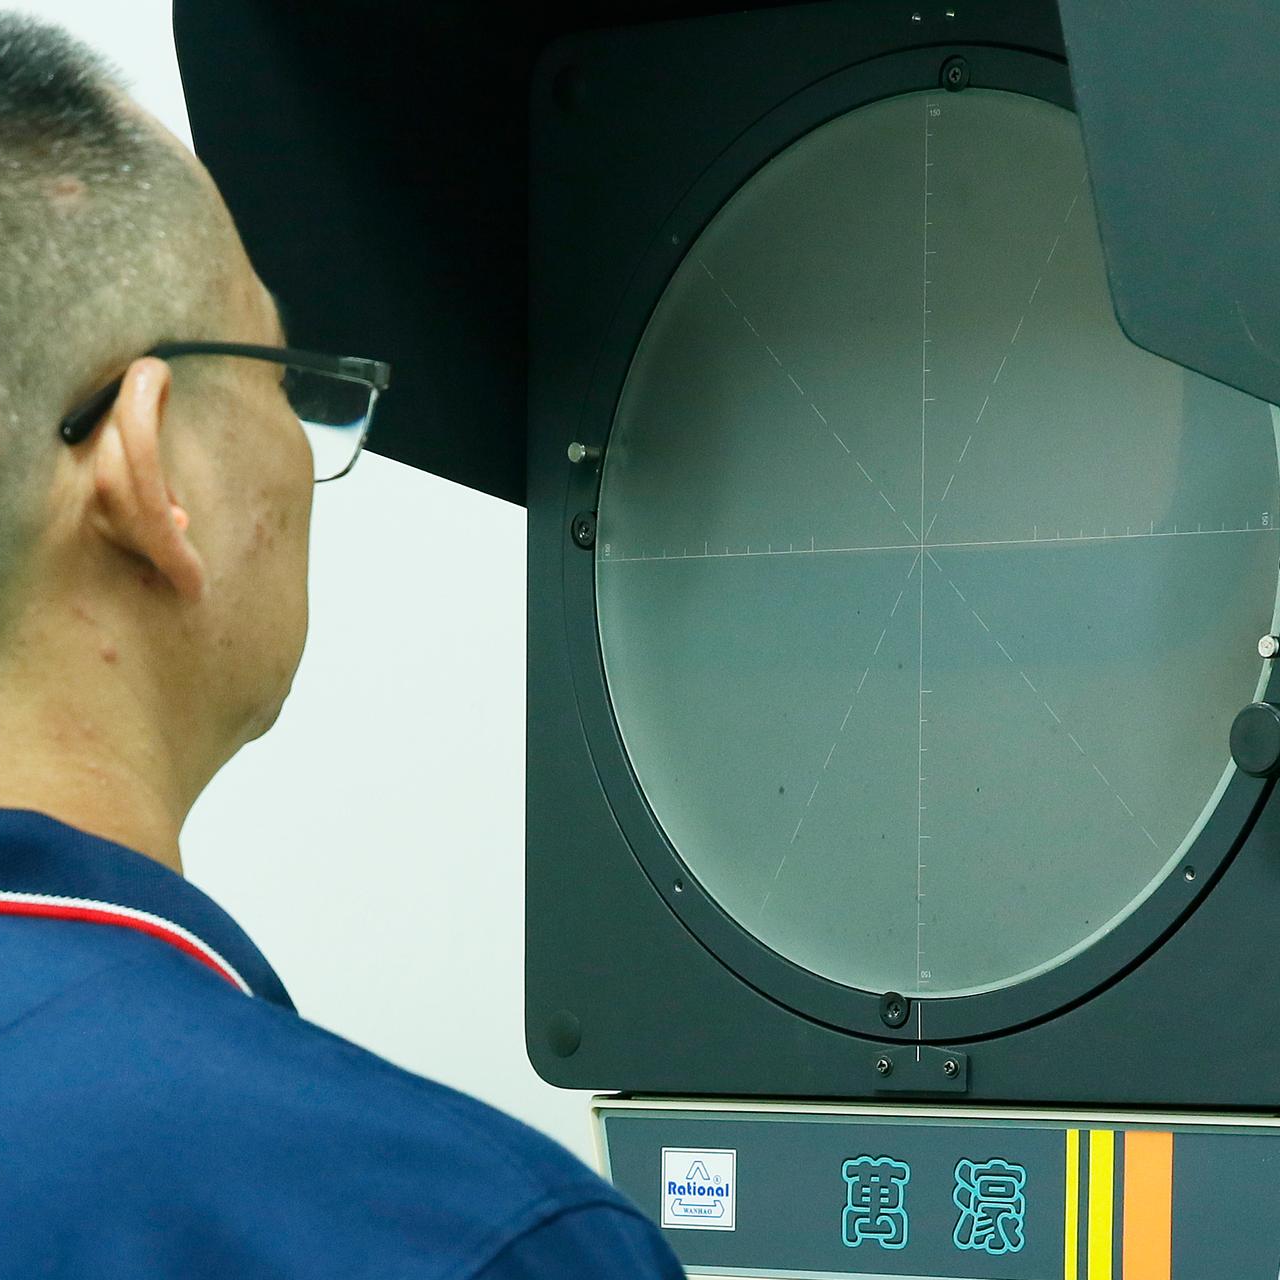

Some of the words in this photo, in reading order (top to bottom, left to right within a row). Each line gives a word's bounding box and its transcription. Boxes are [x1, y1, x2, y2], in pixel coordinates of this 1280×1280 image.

[929, 108, 941, 117] 150
[667, 1180, 730, 1198] Rational
[683, 1207, 713, 1216] WANHAO
